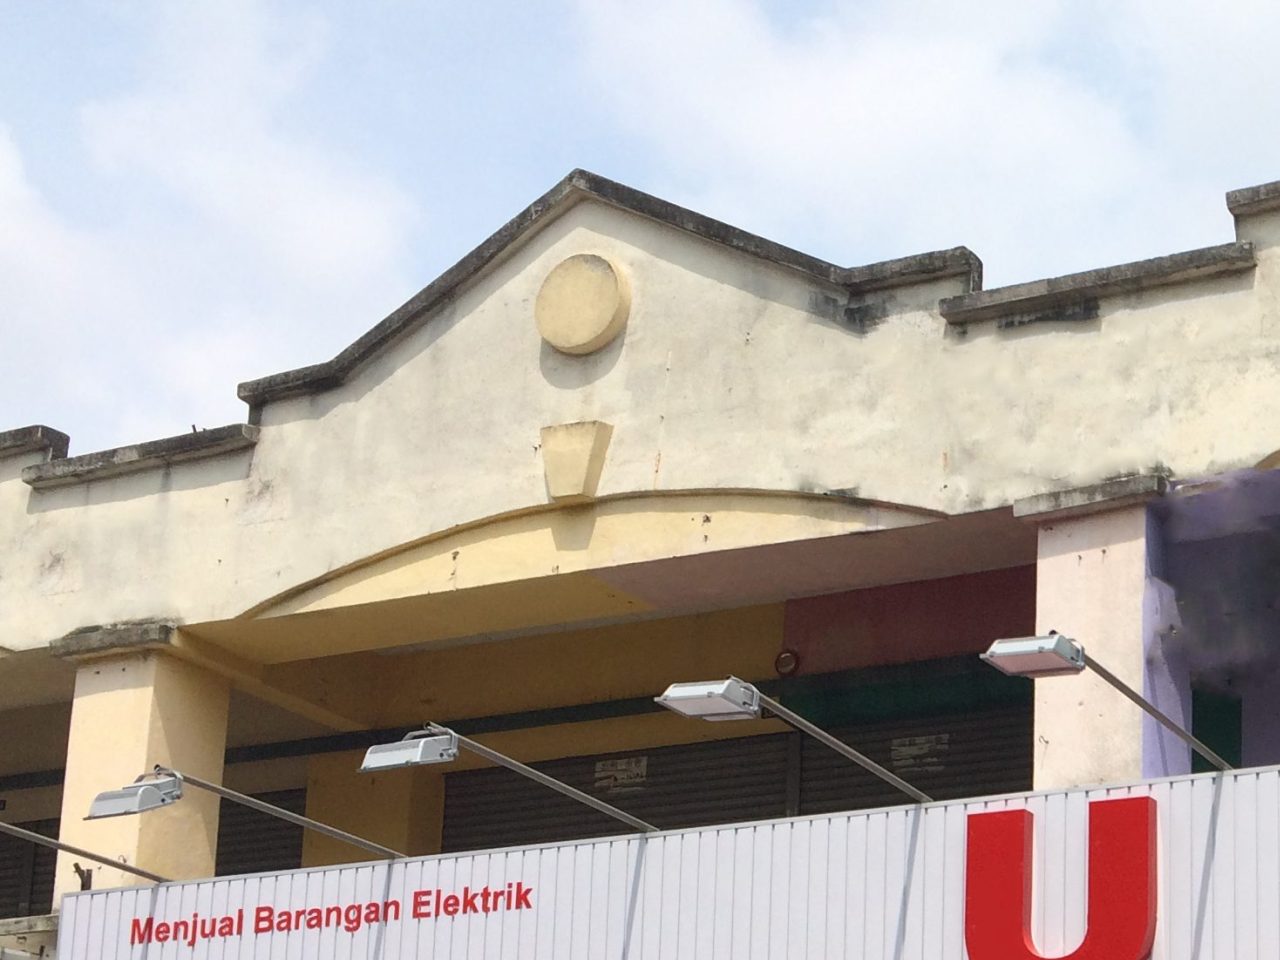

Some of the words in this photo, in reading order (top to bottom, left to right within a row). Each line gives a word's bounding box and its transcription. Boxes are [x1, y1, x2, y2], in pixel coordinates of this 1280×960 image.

[130, 908, 243, 947] Menjual
[254, 899, 400, 933] Barangan
[412, 881, 533, 919] Elektrik
